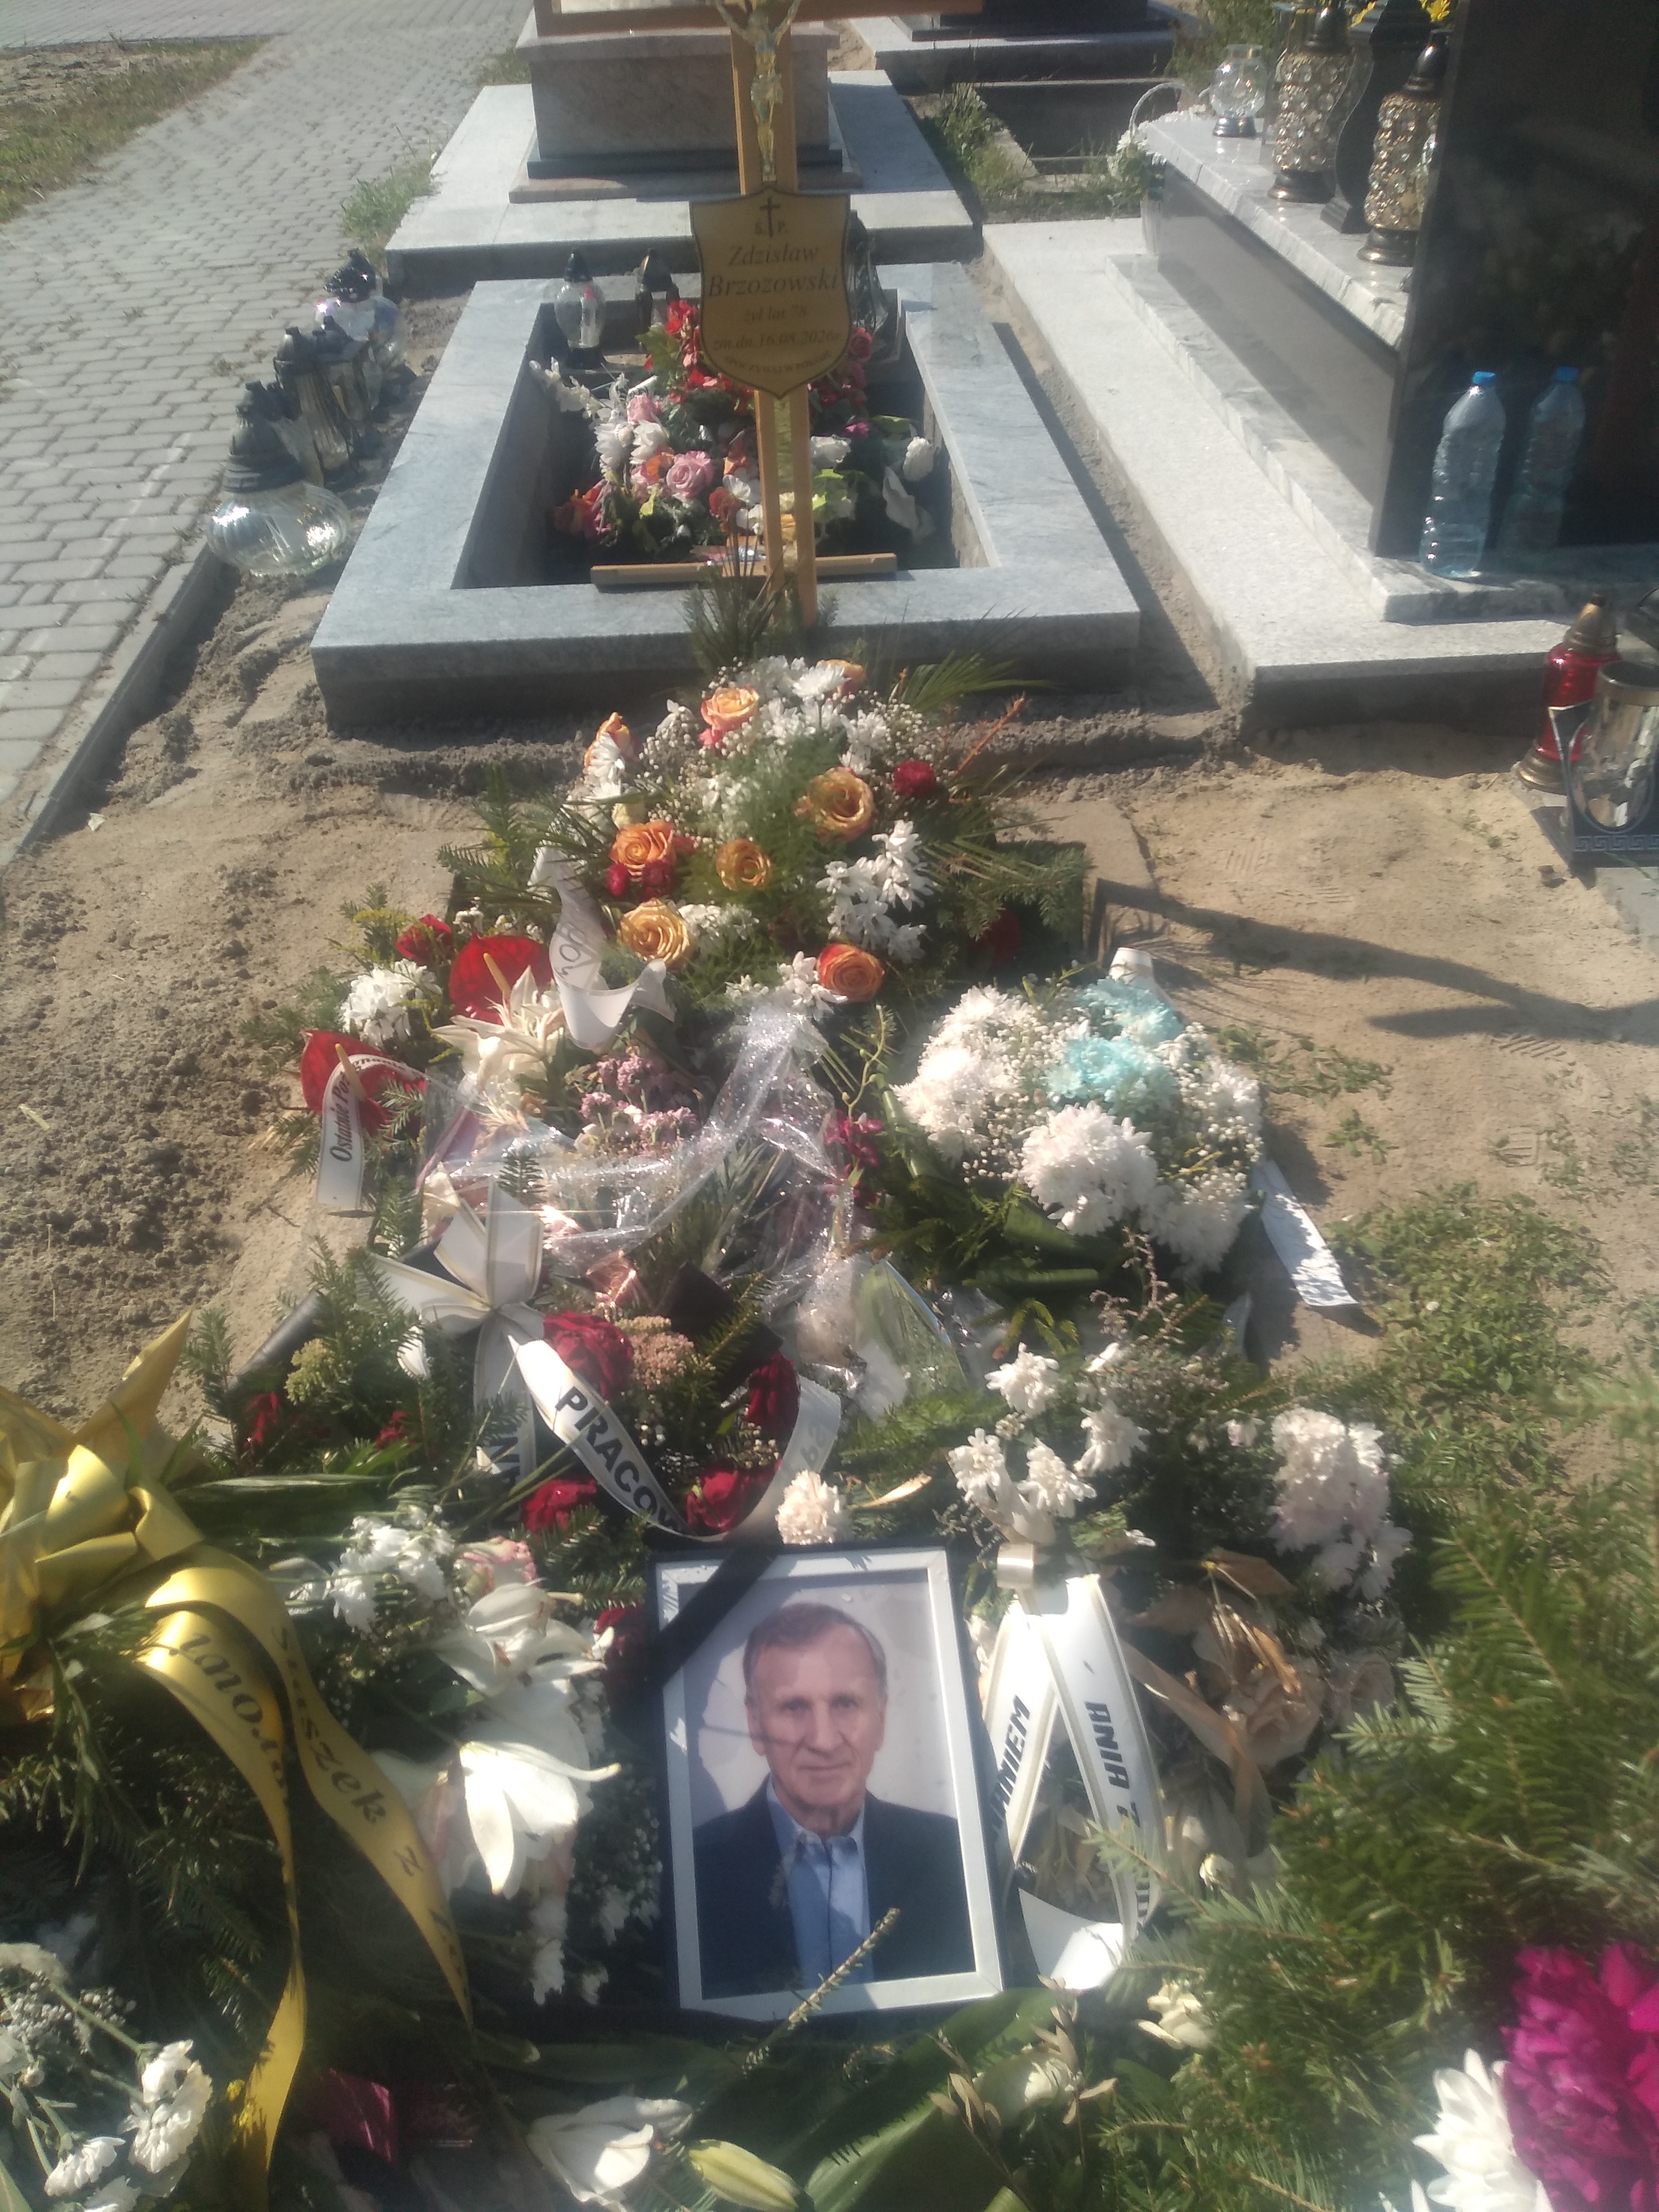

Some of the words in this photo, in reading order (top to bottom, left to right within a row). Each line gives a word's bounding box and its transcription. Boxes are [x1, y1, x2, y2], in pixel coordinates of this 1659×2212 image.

[708, 267, 839, 297] Brzozowski
[330, 1103, 353, 1161] Ostatnie
[1084, 1701, 1130, 1789] ANIA
